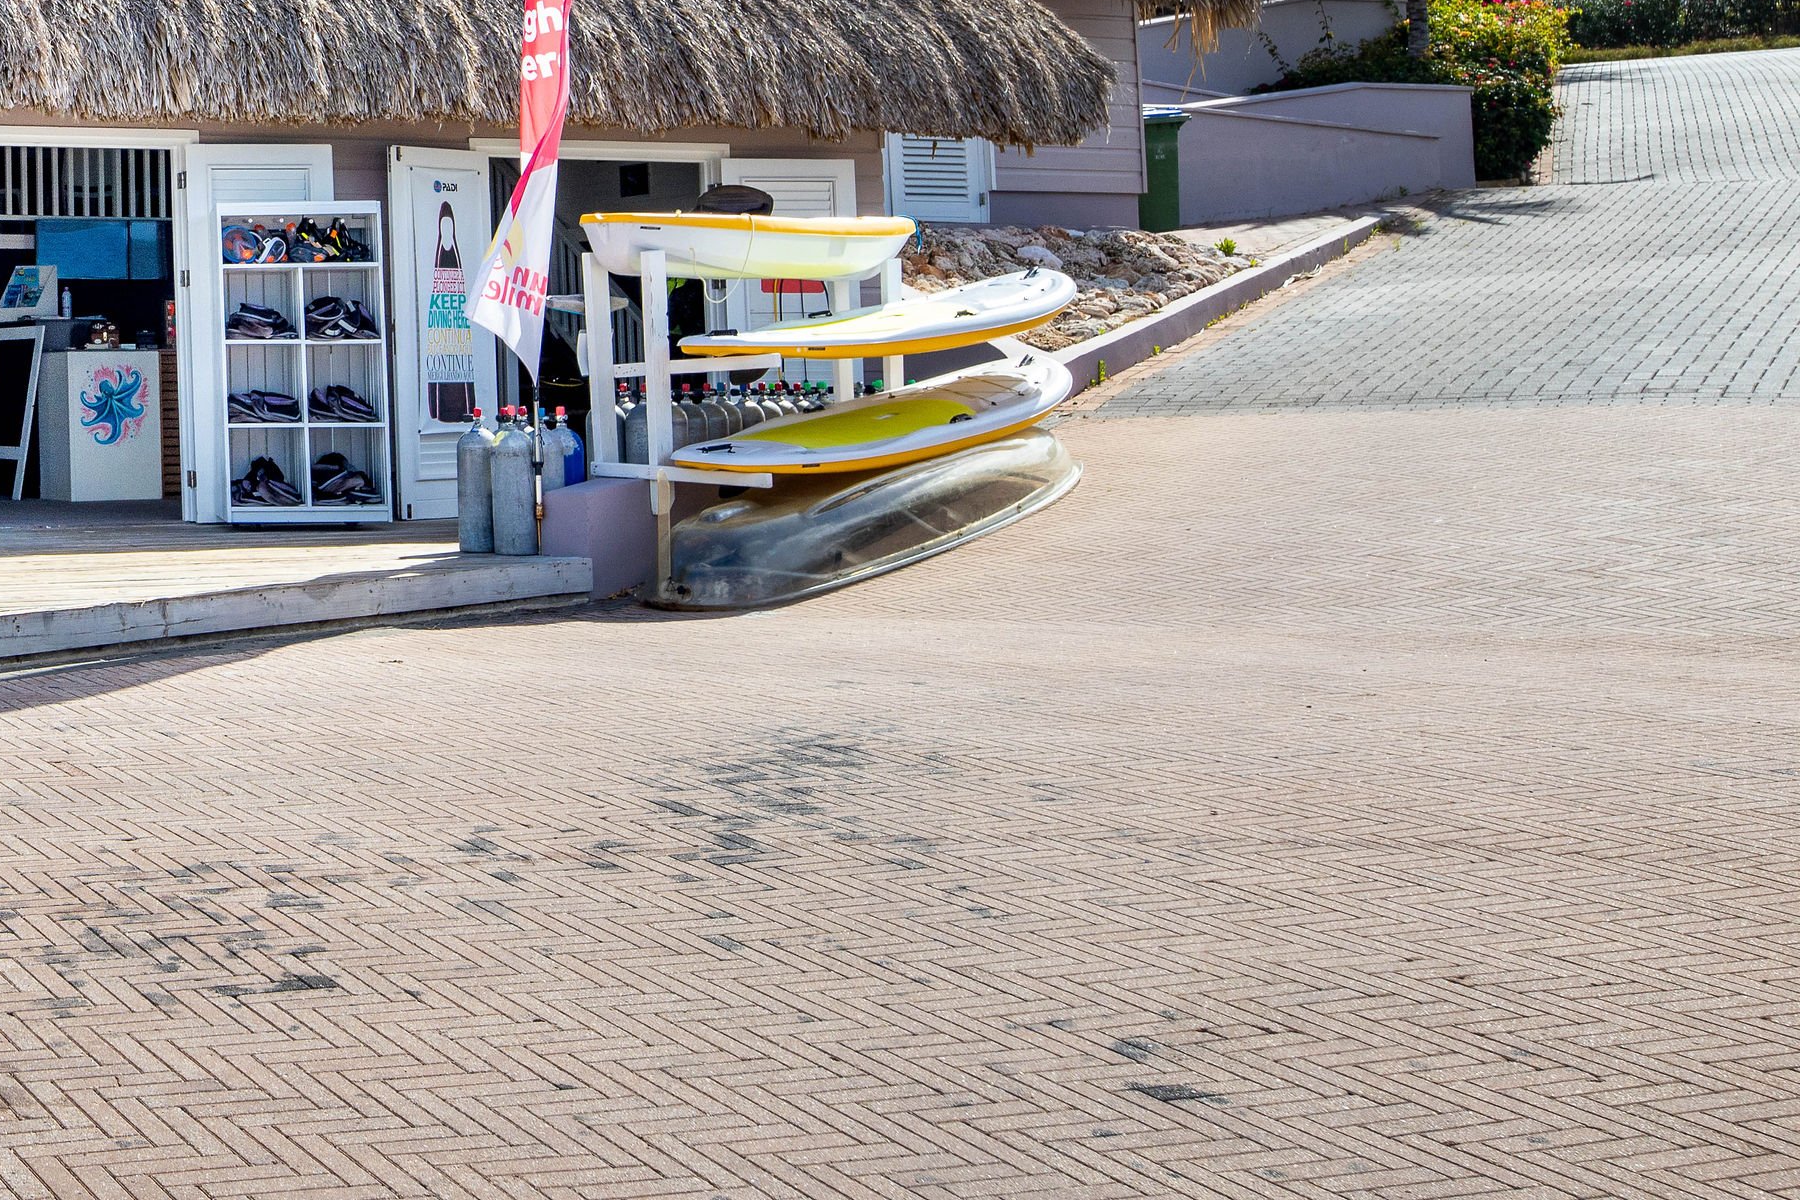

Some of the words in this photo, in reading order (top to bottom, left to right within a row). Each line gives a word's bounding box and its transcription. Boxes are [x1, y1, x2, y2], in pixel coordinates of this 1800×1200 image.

[521, 51, 562, 81] er
[442, 182, 458, 192] PADI
[429, 294, 467, 310] KEEP
[428, 310, 452, 328] DIVING
[428, 329, 472, 344] CONTINUA
[426, 354, 474, 371] CONTINUE
